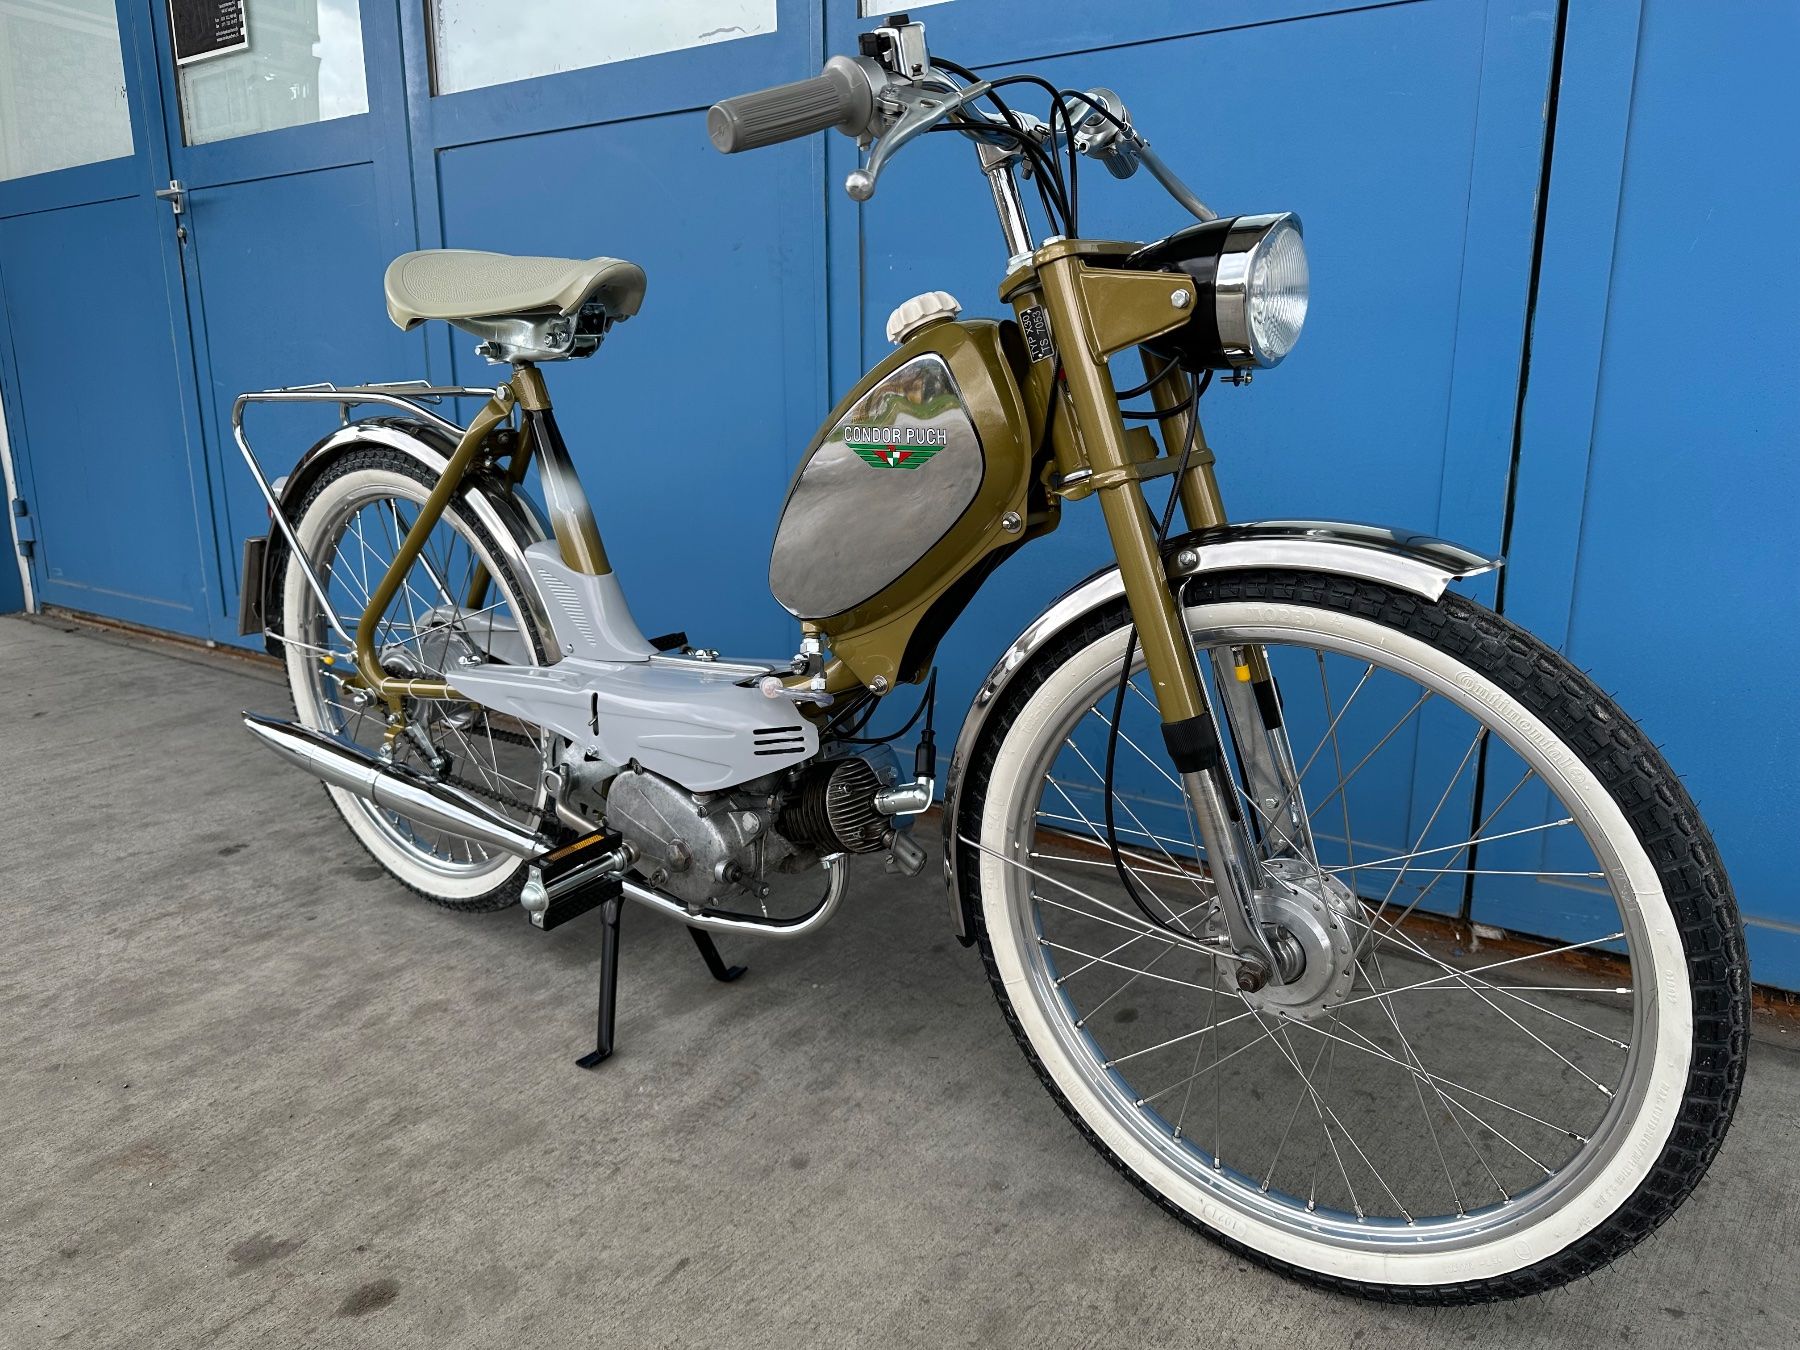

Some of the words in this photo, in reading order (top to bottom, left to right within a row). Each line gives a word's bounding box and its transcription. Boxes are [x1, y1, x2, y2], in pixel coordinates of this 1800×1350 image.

[1022, 315, 1034, 334] X30
[1032, 310, 1046, 334] 7053
[1028, 336, 1039, 357] TYP
[1040, 338, 1050, 353] TS
[844, 426, 901, 443] CONDOR
[906, 428, 947, 445] PUCH
[1455, 671, 1575, 769] Continental
